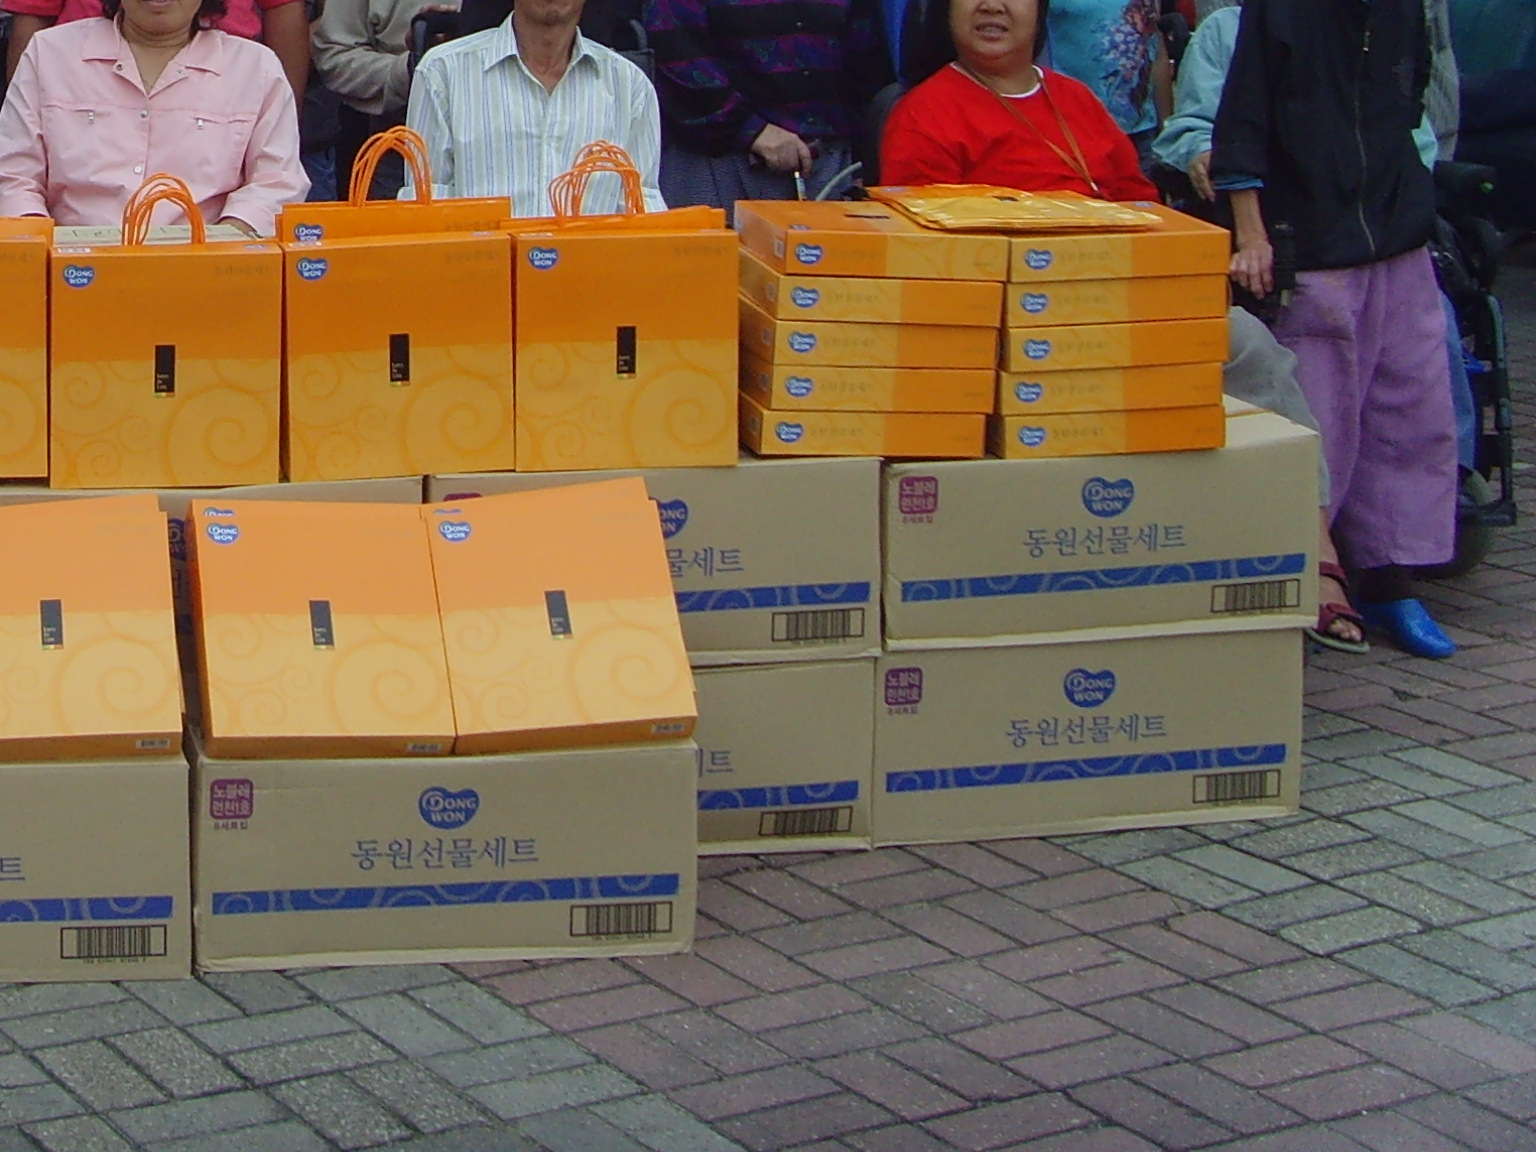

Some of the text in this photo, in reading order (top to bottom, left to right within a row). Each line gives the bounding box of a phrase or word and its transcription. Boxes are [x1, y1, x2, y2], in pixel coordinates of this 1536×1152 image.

[295, 227, 321, 236] DONG
[530, 250, 557, 260] DONG
[298, 260, 326, 270] DONG
[65, 268, 93, 278] DONG
[1085, 482, 1133, 500] DONG
[1092, 501, 1123, 511] WON
[660, 508, 686, 520] ONG
[209, 525, 237, 534] DONG
[441, 523, 469, 532] DONG
[1023, 523, 1186, 558] 동원선물세트
[1067, 673, 1113, 690] DONG
[1074, 691, 1104, 701] WON
[1006, 713, 1166, 747] 동원선물세트
[213, 784, 251, 799] 노블레
[422, 791, 477, 811] DONG
[431, 811, 466, 823] WON
[351, 836, 539, 870] 동원선물세트
